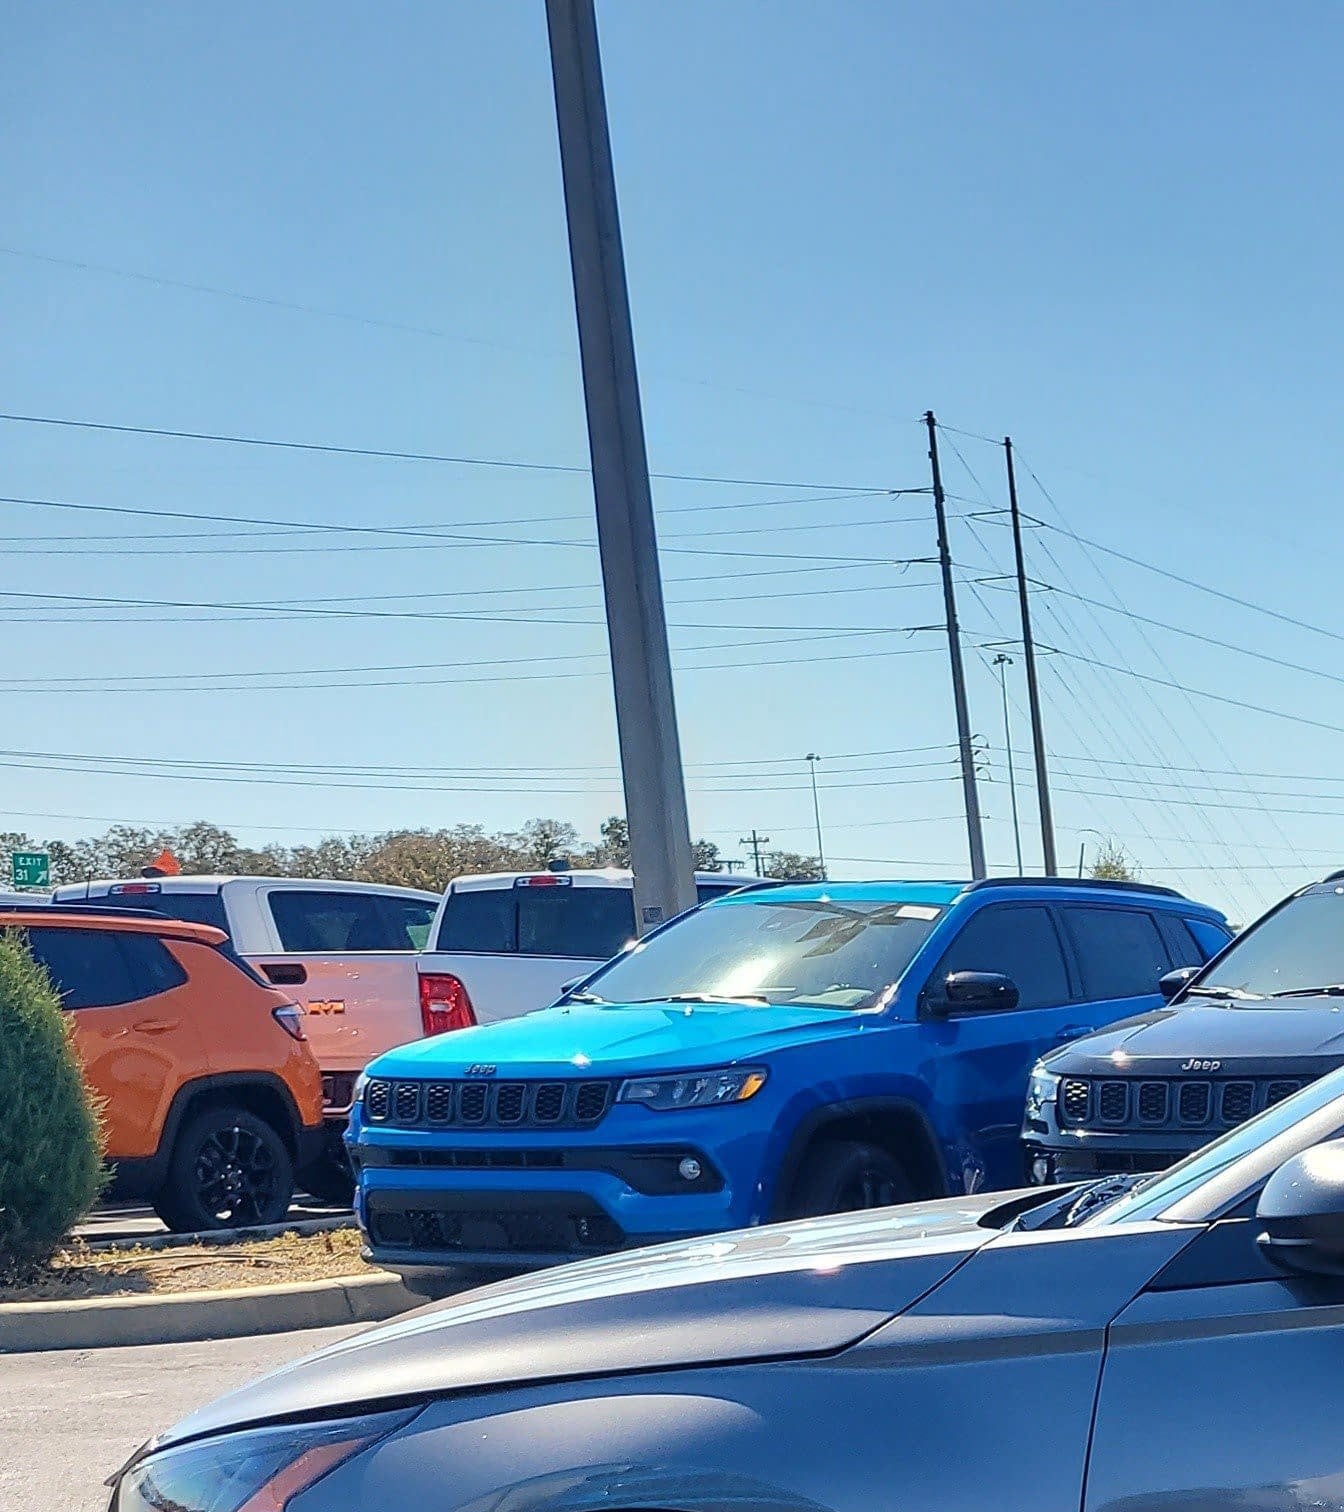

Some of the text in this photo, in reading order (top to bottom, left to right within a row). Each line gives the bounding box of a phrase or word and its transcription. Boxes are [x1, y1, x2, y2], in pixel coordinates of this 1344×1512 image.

[18, 857, 42, 866] EXIT
[15, 868, 29, 881] 31
[463, 1062, 497, 1076] Jeep
[1181, 1058, 1221, 1072] Jeep
